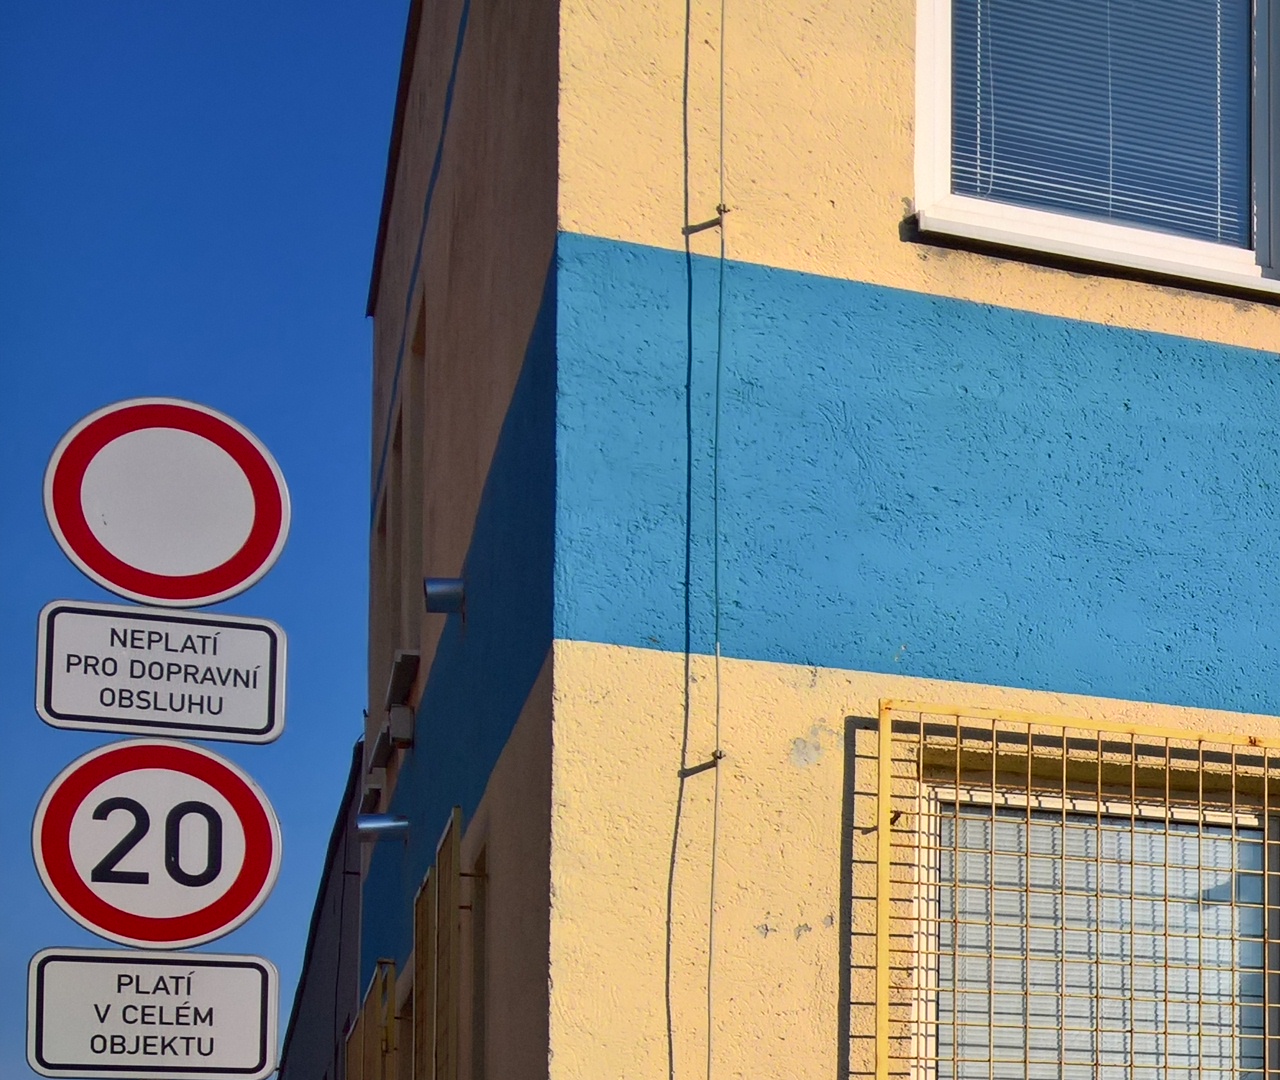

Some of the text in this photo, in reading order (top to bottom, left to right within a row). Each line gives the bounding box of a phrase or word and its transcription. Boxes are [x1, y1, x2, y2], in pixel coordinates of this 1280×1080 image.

[110, 627, 221, 656] NEPLATÍ
[66, 653, 262, 689] PRO DOPRAVNÍ
[99, 687, 223, 715] OBSLUHU
[91, 796, 223, 887] 20
[117, 971, 195, 995] PLATÍ
[93, 1001, 214, 1027] V CELÉM
[90, 1034, 214, 1057] OBJEKTU
